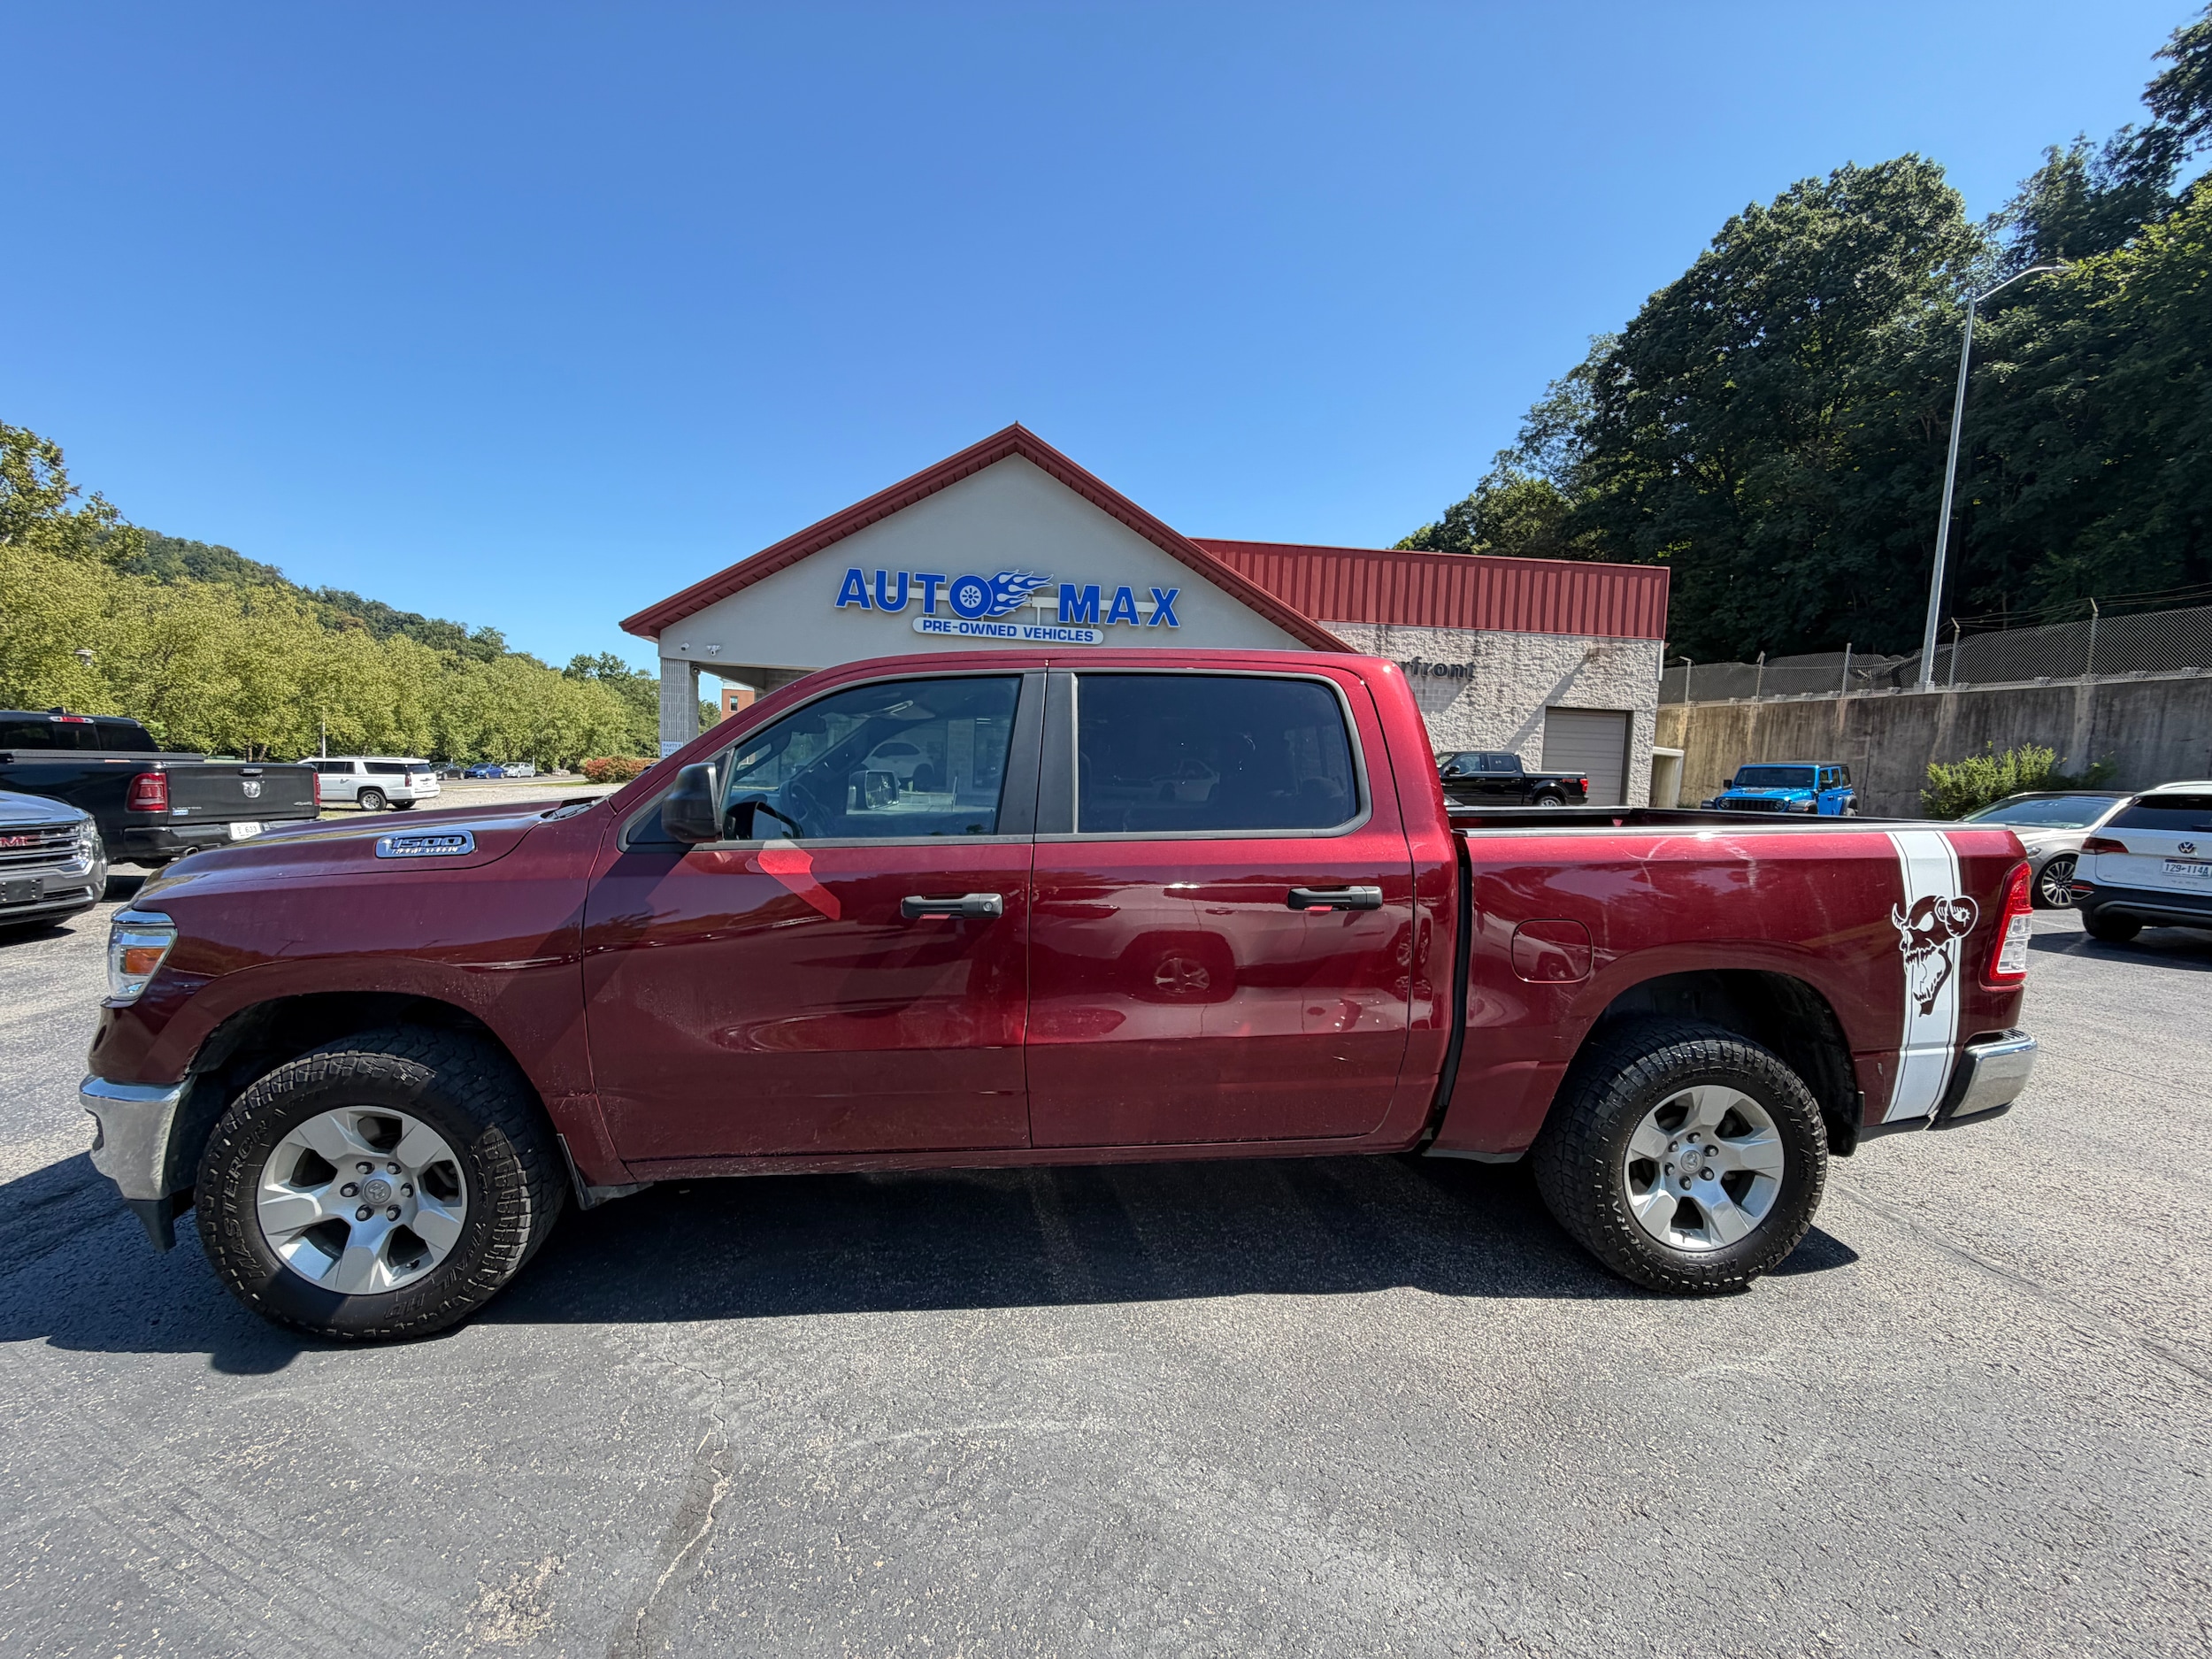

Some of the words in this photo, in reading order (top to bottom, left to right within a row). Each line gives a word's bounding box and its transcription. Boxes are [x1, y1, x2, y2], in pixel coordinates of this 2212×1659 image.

[833, 567, 994, 619] AUTO
[1057, 582, 1181, 628] MAX
[922, 619, 1018, 638] PRE-OWNED
[1023, 626, 1094, 642] VEHICLES
[1400, 656, 1476, 680] rfront
[0, 834, 41, 849] MC
[392, 836, 463, 849] 1500
